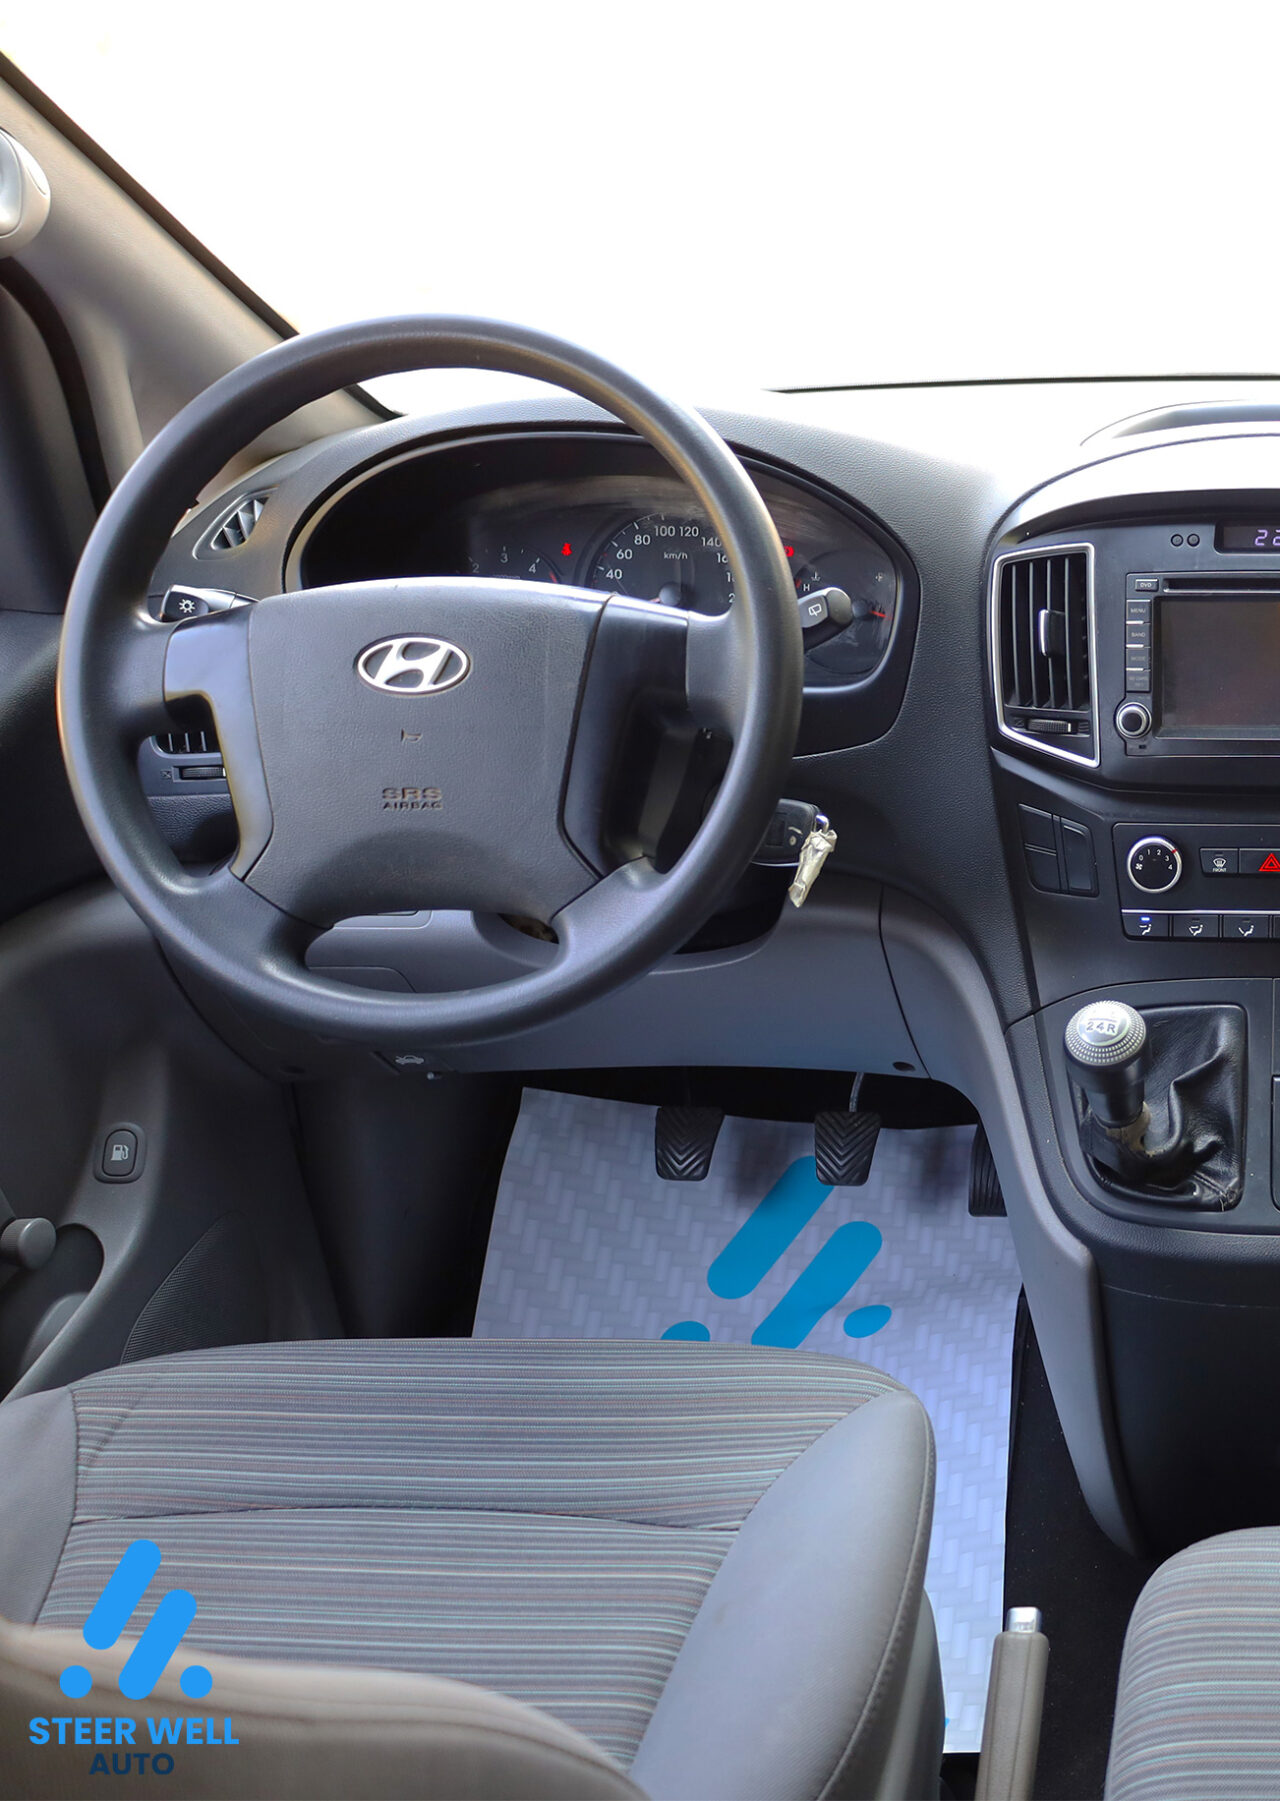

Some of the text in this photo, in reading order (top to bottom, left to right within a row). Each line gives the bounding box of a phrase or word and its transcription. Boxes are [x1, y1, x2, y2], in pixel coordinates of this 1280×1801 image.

[654, 525, 676, 537] 100
[679, 526, 699, 537] 120
[634, 534, 651, 545] 80
[500, 553, 508, 563] 3
[616, 548, 633, 560] 60
[663, 551, 688, 560] km/h
[528, 563, 537, 573] 4
[605, 568, 623, 580] 40
[382, 787, 442, 800] SRS
[382, 801, 442, 810] AIRBAG
